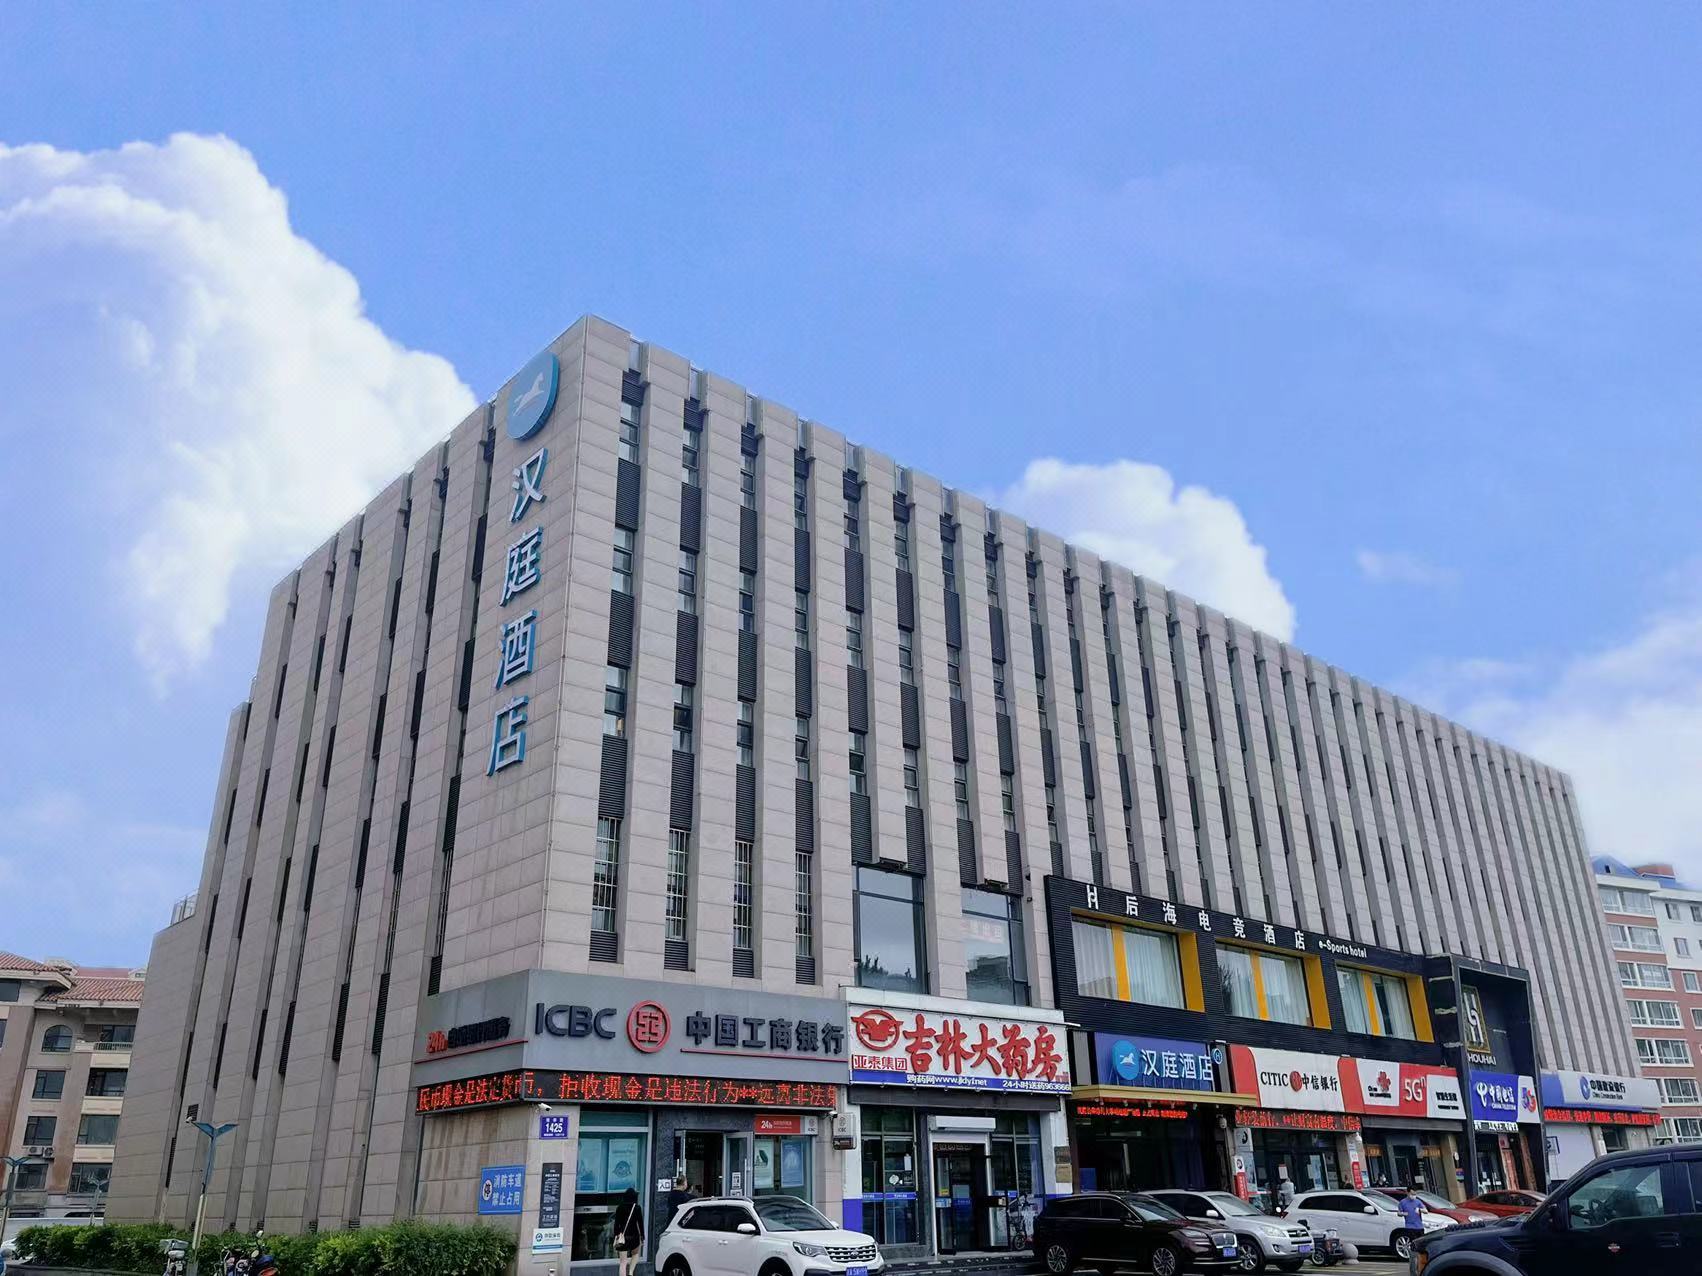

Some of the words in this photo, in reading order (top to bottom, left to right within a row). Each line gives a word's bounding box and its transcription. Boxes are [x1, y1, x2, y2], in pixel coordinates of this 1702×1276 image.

[487, 447, 548, 778] 汉庭酒店
[1125, 895, 1307, 951] 后海电竞酒店
[1319, 940, 1349, 956] e-Sports
[1350, 946, 1367, 958] hotel
[534, 1002, 617, 1040] ICBC
[685, 1009, 847, 1055] 中国工商银行
[902, 1013, 1063, 1082] 吉林大药房
[852, 1054, 908, 1071] 亚泰集团
[1140, 1047, 1213, 1082] 汉庭酒店
[1467, 1053, 1497, 1065] HOUHAI
[1260, 1071, 1289, 1087] CITIC
[1302, 1073, 1338, 1092] 中信银行
[545, 1122, 563, 1133] 1425
[493, 1173, 522, 1188] 消防车道
[658, 1180, 671, 1191] 入口
[492, 1191, 521, 1206] 禁止占用
